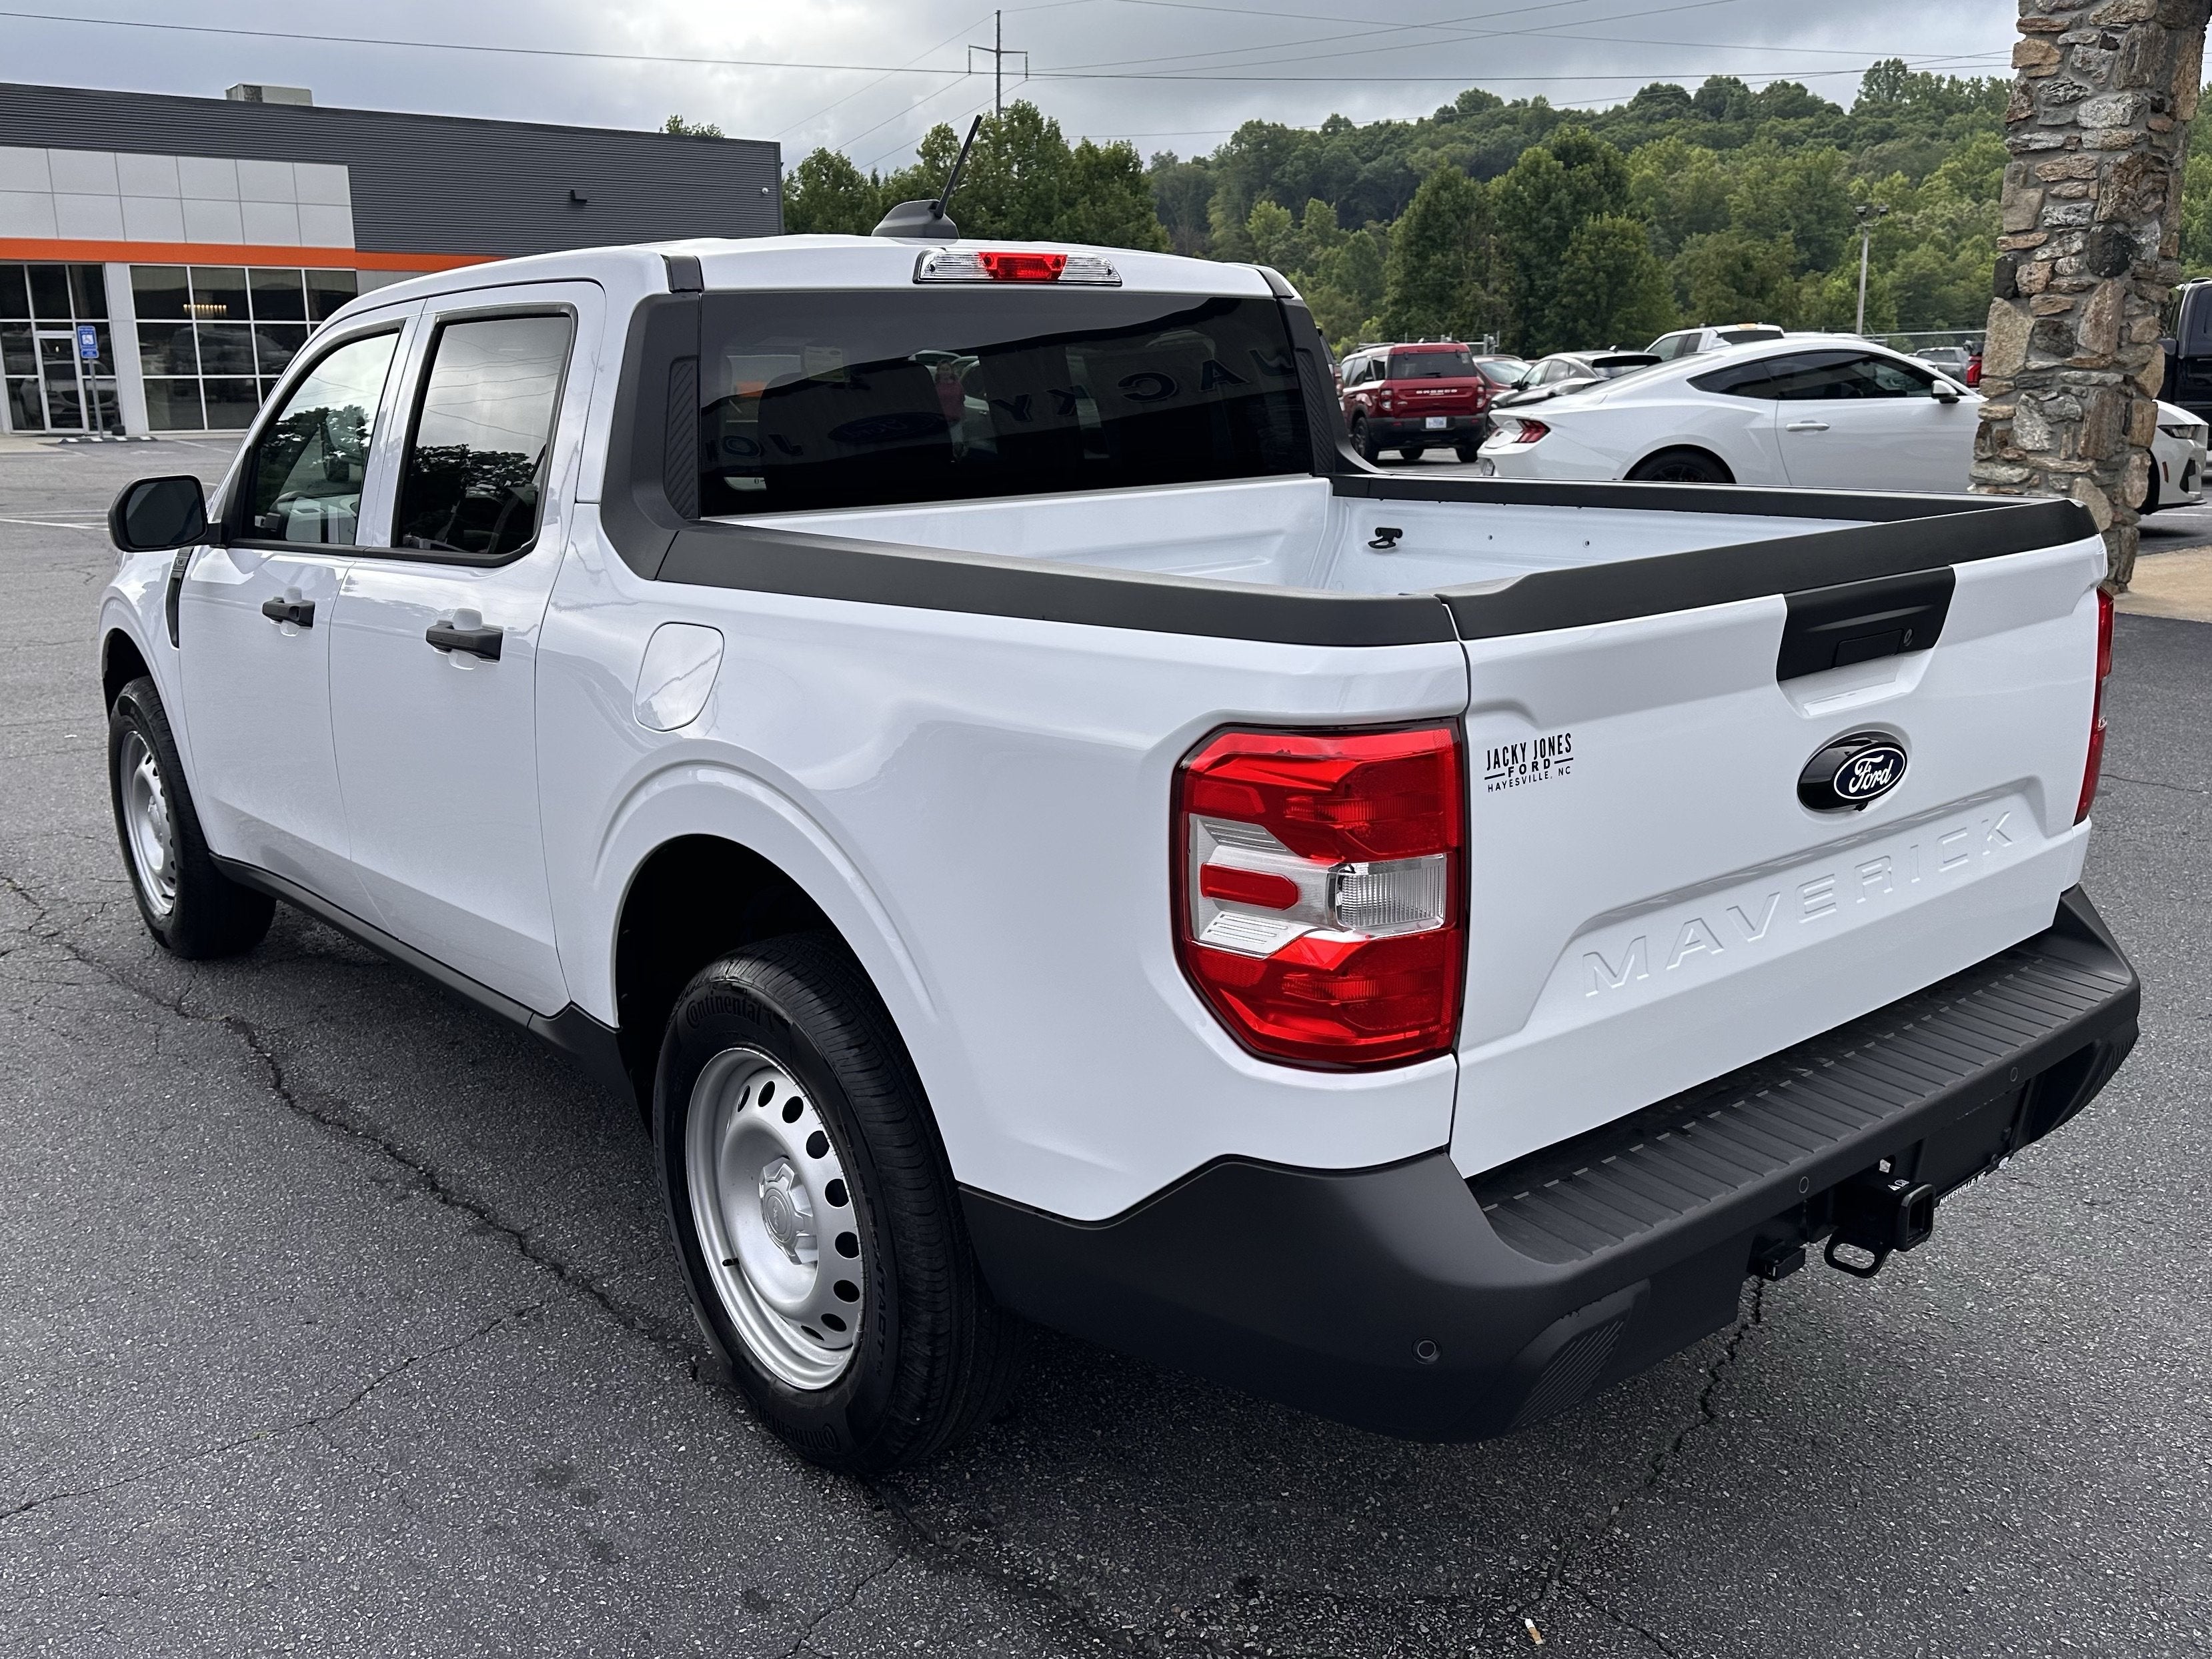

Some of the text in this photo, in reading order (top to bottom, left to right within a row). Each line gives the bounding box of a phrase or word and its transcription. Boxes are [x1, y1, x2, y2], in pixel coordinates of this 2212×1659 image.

[1486, 733, 1572, 771] JACKY JONES
[1508, 758, 1551, 777] FORD
[1488, 766, 1571, 793] HAYESVILLE, NC
[1849, 754, 1895, 793] Ford
[1582, 811, 2013, 997] MAVERICK
[686, 992, 761, 1029] Continental
